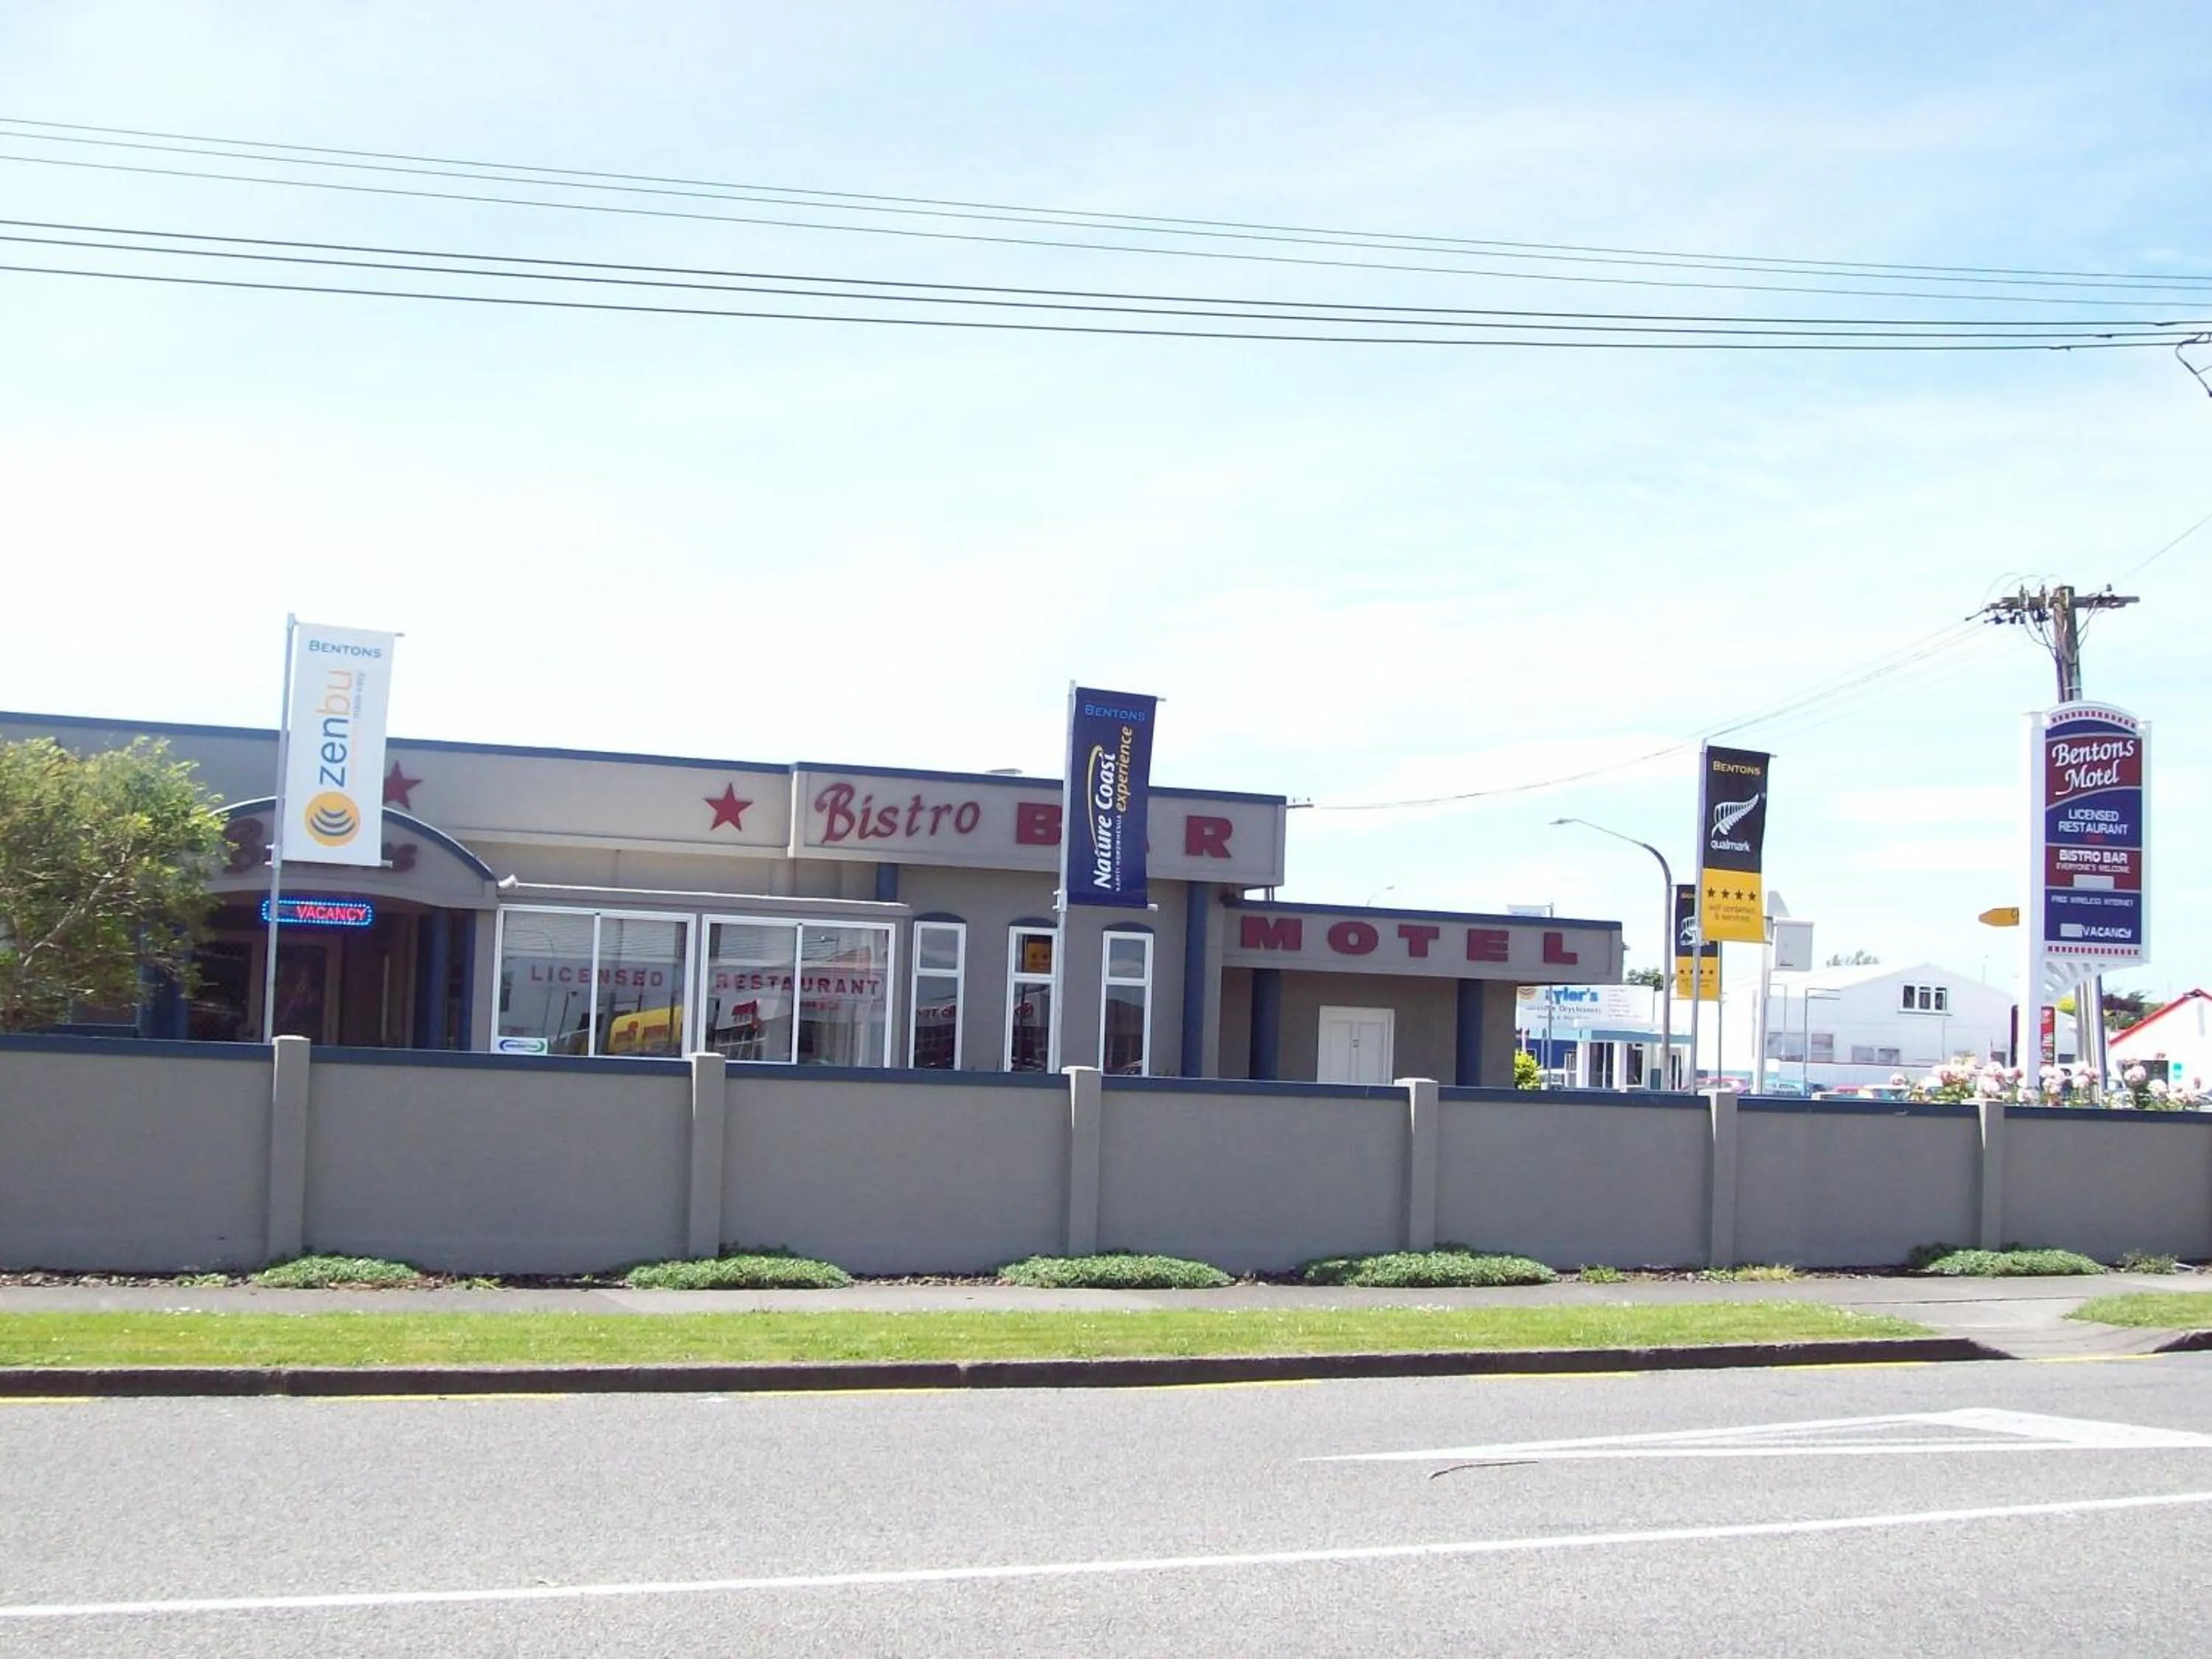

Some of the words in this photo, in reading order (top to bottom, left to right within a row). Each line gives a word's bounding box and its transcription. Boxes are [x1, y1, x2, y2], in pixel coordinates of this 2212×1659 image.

[308, 639, 382, 658] BENTONS
[1085, 704, 1145, 721] BENTONS
[315, 669, 352, 787] zenbu
[2052, 740, 2134, 768] Bentons
[1116, 726, 1133, 813] experience
[1713, 760, 1761, 776] BENTONS
[2055, 759, 2120, 795] Motel
[1095, 753, 1116, 812] Coast
[815, 782, 981, 844] Bistro
[1016, 801, 1233, 860] BR
[2068, 808, 2120, 822] LICENSED
[2058, 821, 2129, 835] RESTAURANT
[1093, 815, 1112, 888] Nature
[1710, 840, 1751, 852] qualmark
[2059, 849, 2101, 863] BISTRO
[2103, 851, 2128, 865] BAR
[296, 905, 366, 921] VACANCY
[1240, 915, 1578, 965] MOTEL
[2081, 926, 2132, 939] VACANCY
[530, 964, 664, 988] LICENSED
[715, 973, 880, 995] RESTAURANT
